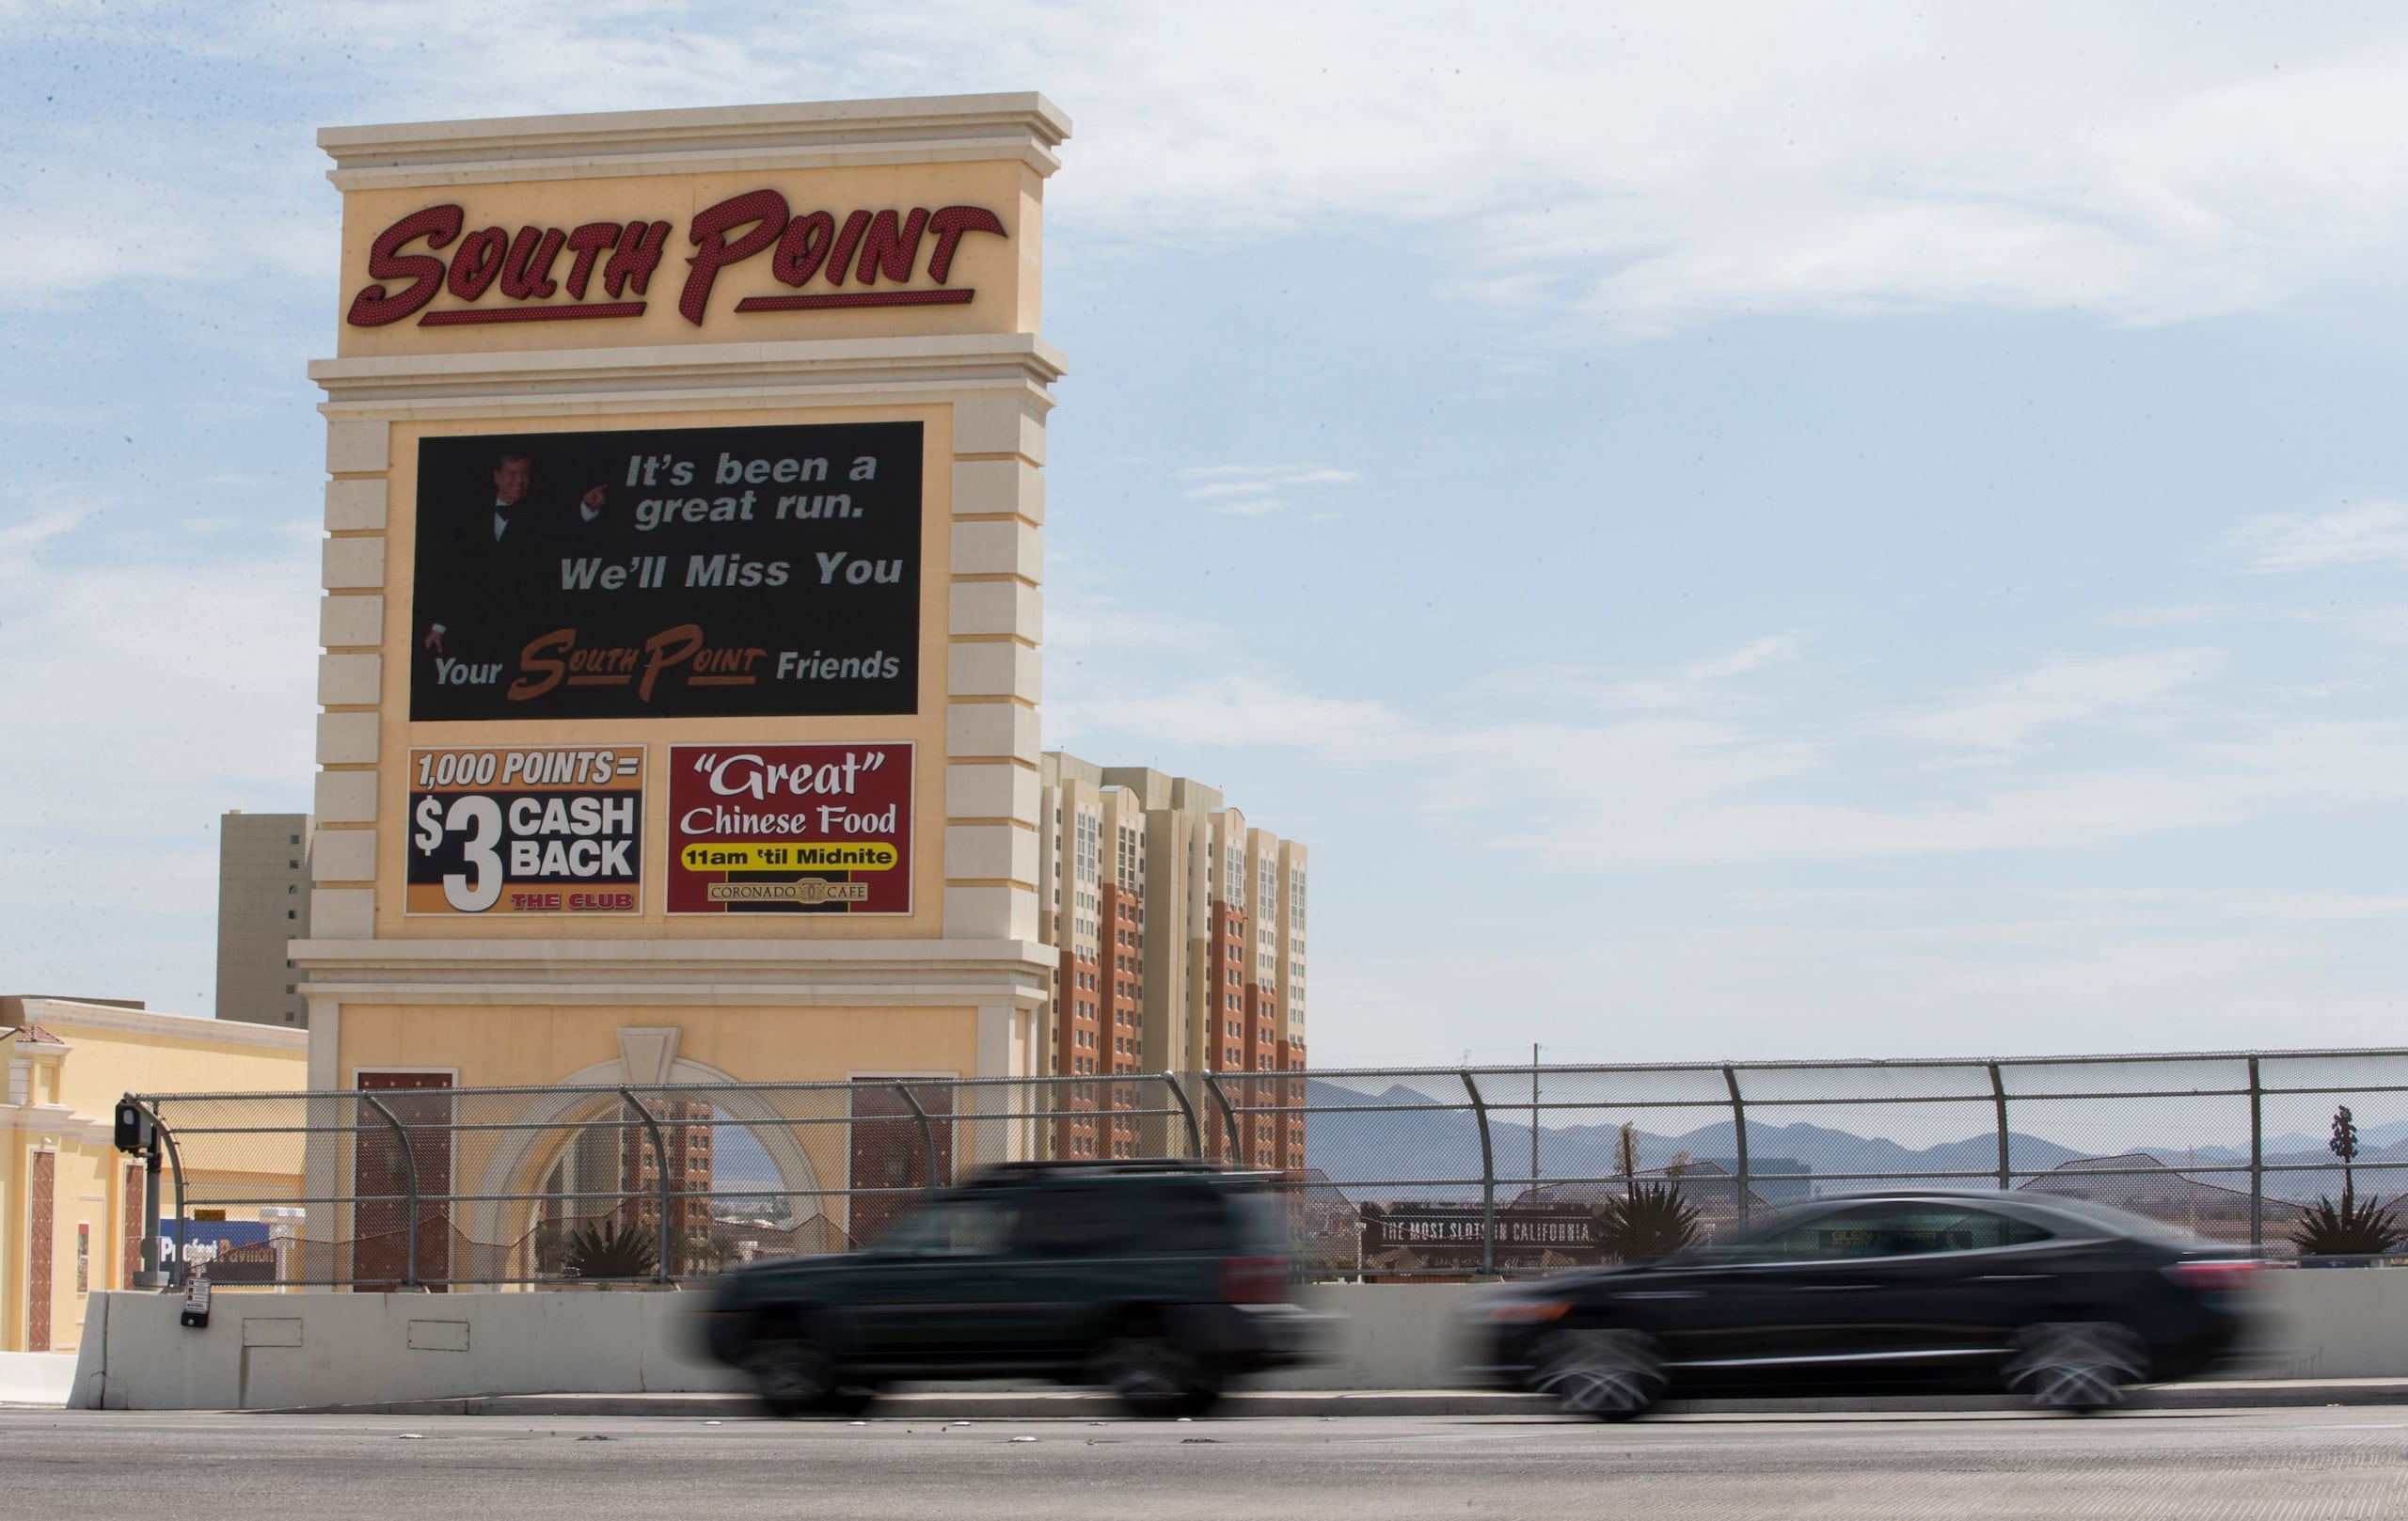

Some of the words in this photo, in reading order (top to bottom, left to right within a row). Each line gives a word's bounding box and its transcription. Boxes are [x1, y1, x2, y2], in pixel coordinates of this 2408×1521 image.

[347, 203, 673, 326] SOUTH
[678, 188, 1009, 326] POINT
[626, 454, 693, 486] It's
[715, 452, 828, 484] been
[849, 455, 877, 481] a
[635, 490, 755, 531] great
[775, 493, 863, 519] run.
[561, 555, 667, 590] We'll
[685, 553, 790, 587] Miss
[815, 551, 903, 584] You
[435, 657, 501, 685] Your
[506, 628, 644, 701] SOUTH
[638, 624, 767, 702] POINT
[776, 651, 900, 680] Friends
[419, 753, 497, 790] 1,000
[501, 751, 640, 784] POINTS=
[694, 752, 885, 800] "Great"
[509, 797, 634, 836] CASH
[680, 804, 806, 834] Chinese
[816, 803, 896, 834] Food
[415, 795, 503, 911] $3
[511, 839, 634, 877] BACK
[687, 849, 748, 864] 11am
[757, 848, 787, 864] 'til
[797, 848, 893, 864] Midnite
[511, 893, 561, 910] THE
[568, 893, 634, 910] CLUB
[711, 886, 796, 898] CORONADO
[827, 886, 865, 898] CAFE
[161, 1237, 218, 1262] Prefert
[1382, 1222, 1404, 1240] THE
[1410, 1222, 1443, 1240] MOST
[1494, 1223, 1507, 1240] IN
